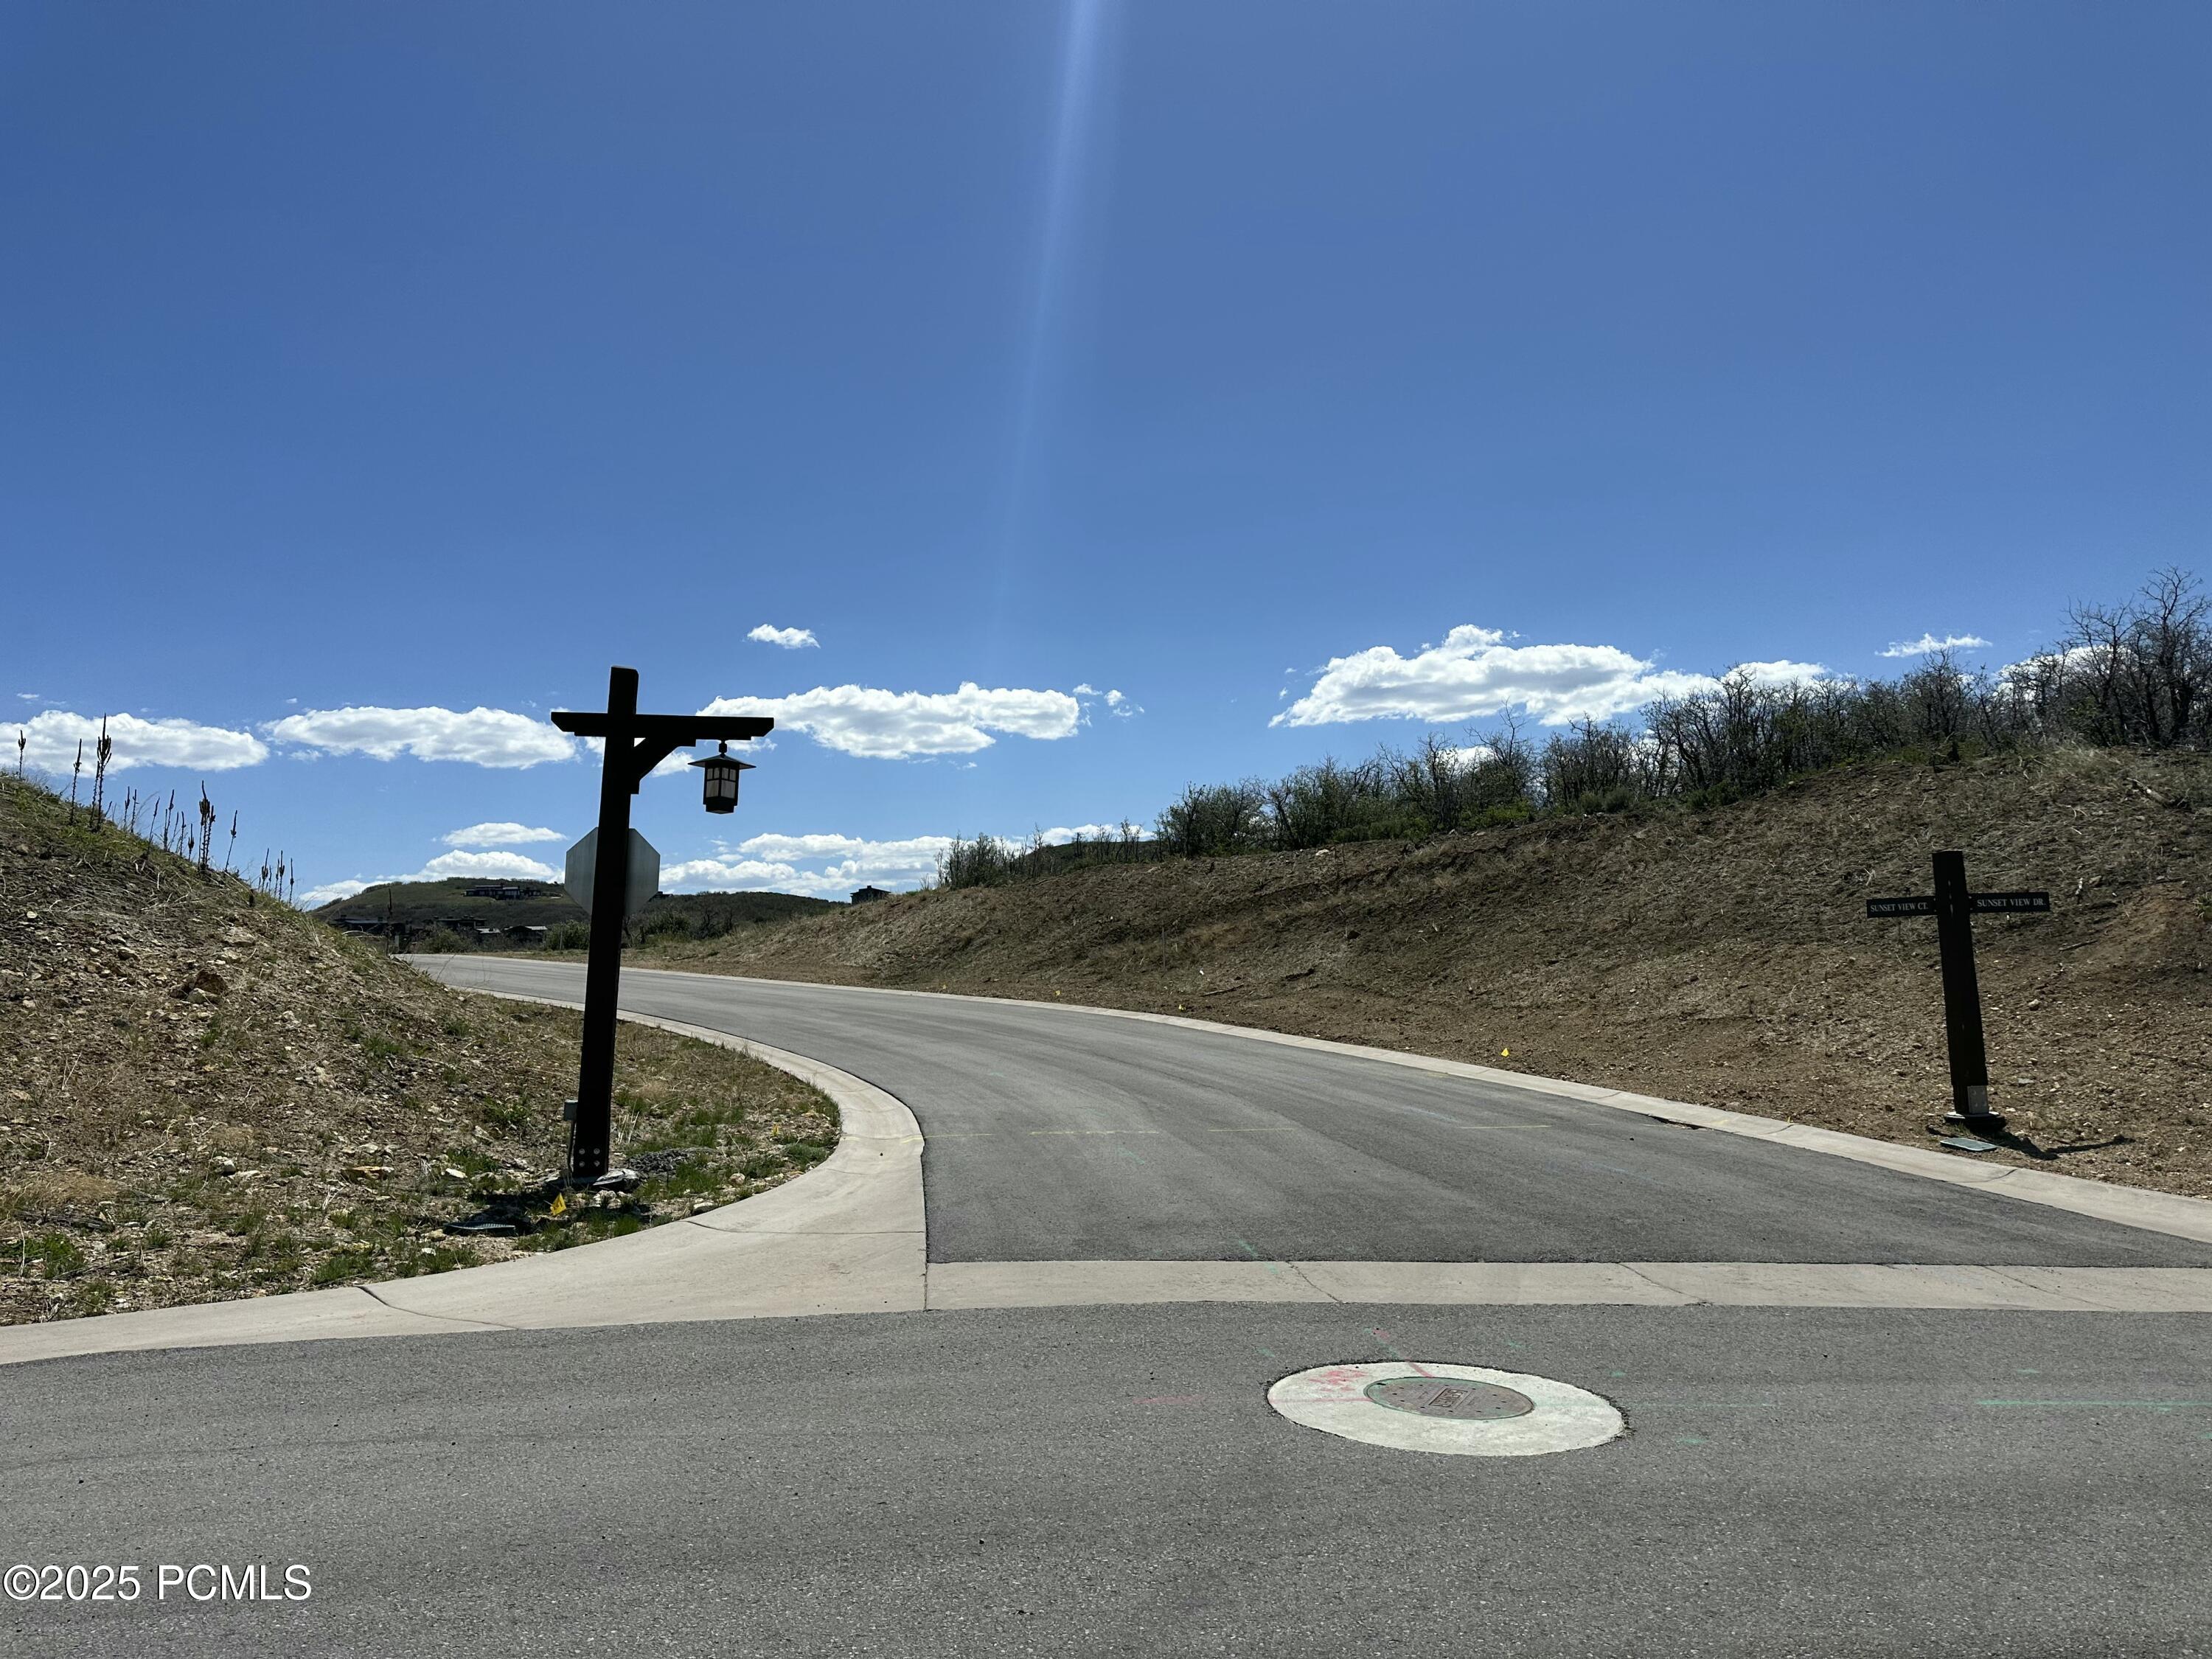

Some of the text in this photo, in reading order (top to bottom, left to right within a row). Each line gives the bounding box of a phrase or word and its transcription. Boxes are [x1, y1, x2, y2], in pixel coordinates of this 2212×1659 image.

[1871, 902, 1928, 912] SUNSET VIEW CT.
[1977, 898, 2046, 907] SUNSET VIEW DR.
